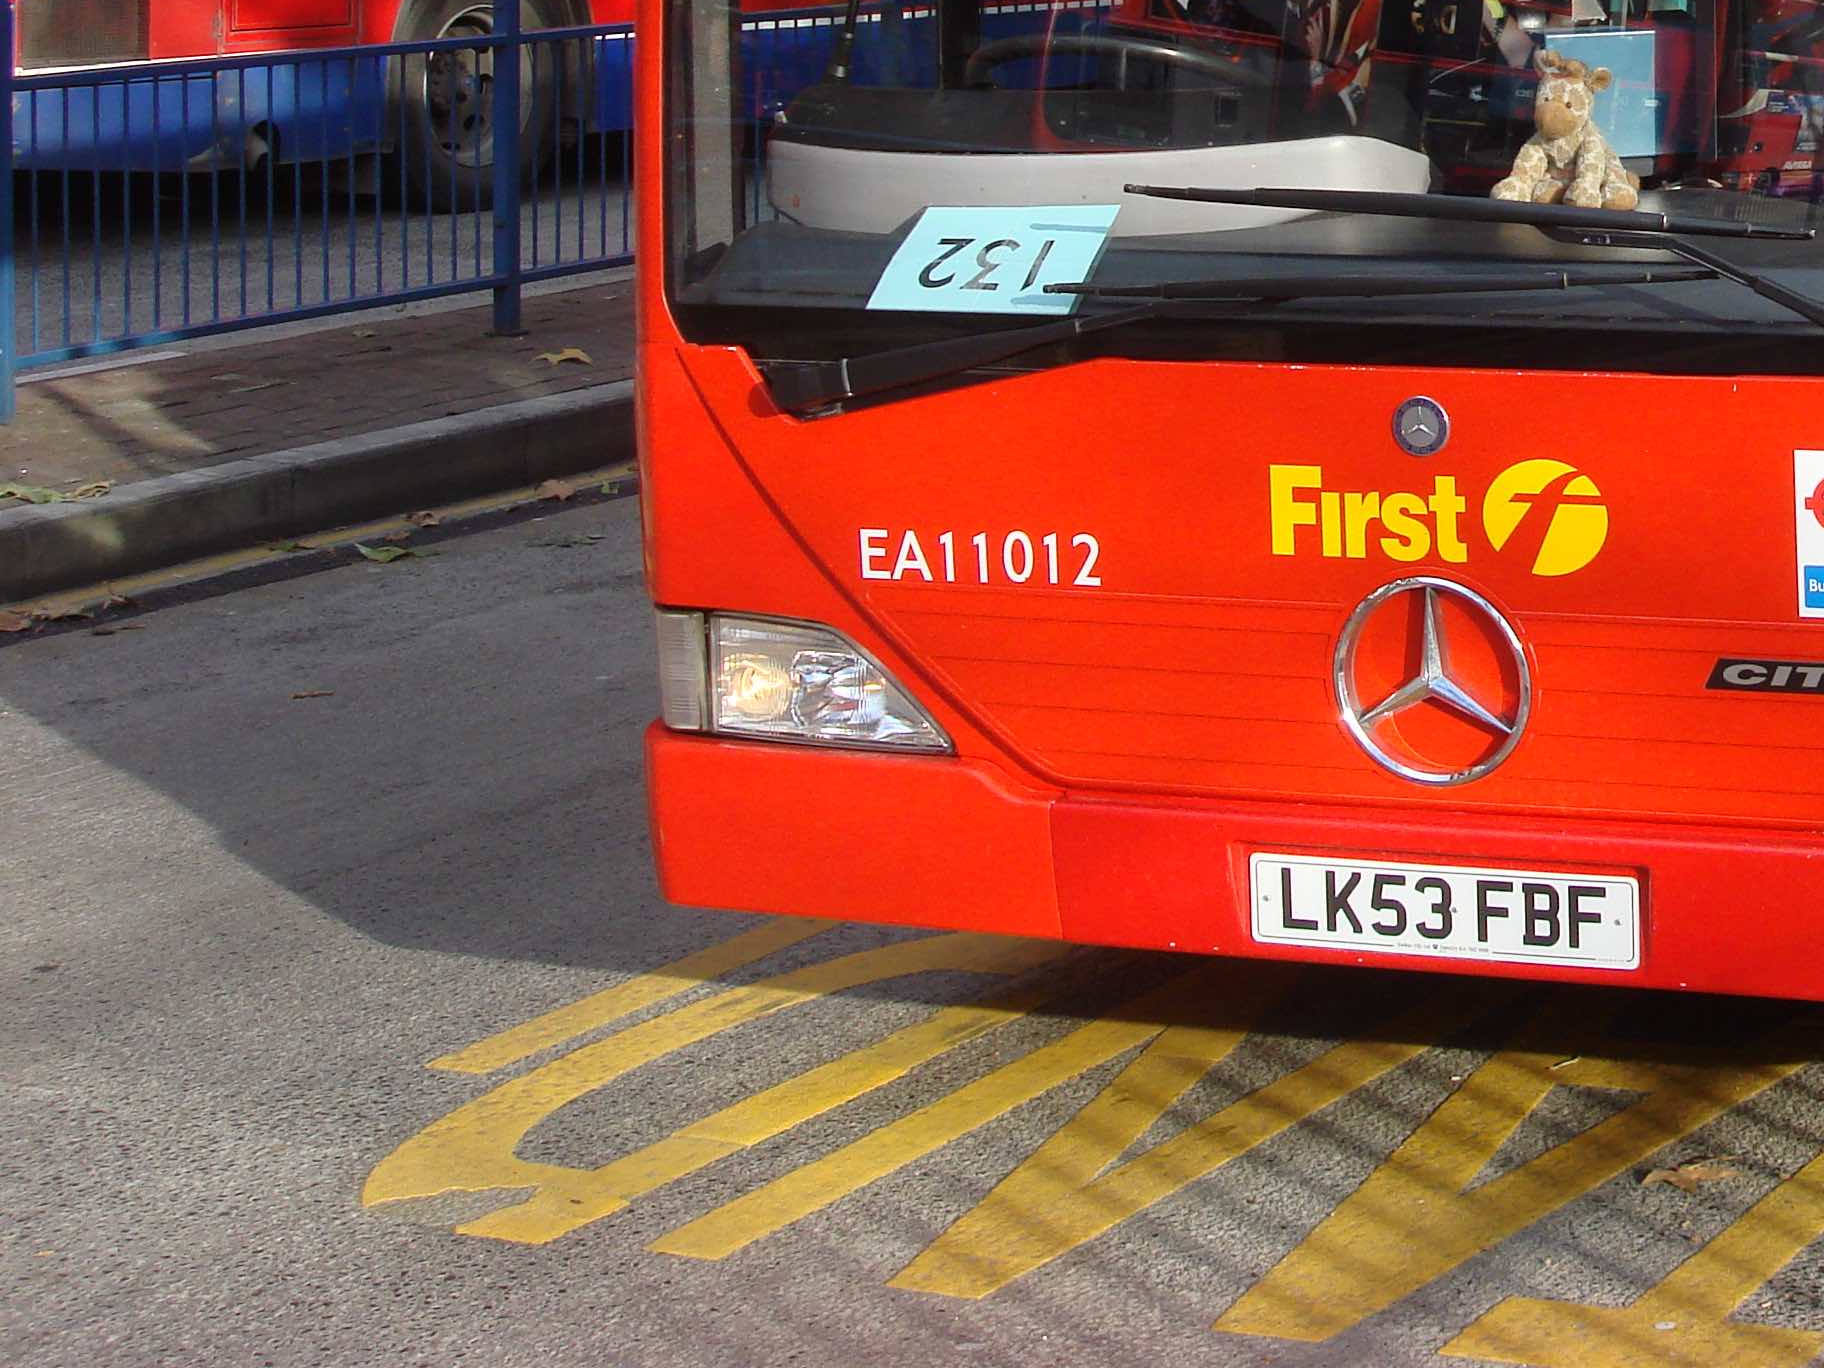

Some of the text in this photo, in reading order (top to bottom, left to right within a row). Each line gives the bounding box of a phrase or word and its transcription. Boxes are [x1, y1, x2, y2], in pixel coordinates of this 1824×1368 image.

[917, 237, 1056, 292] 132
[1268, 464, 1469, 563] First
[860, 527, 1102, 588] EA11012
[1281, 867, 1607, 949] LK53 FBF
